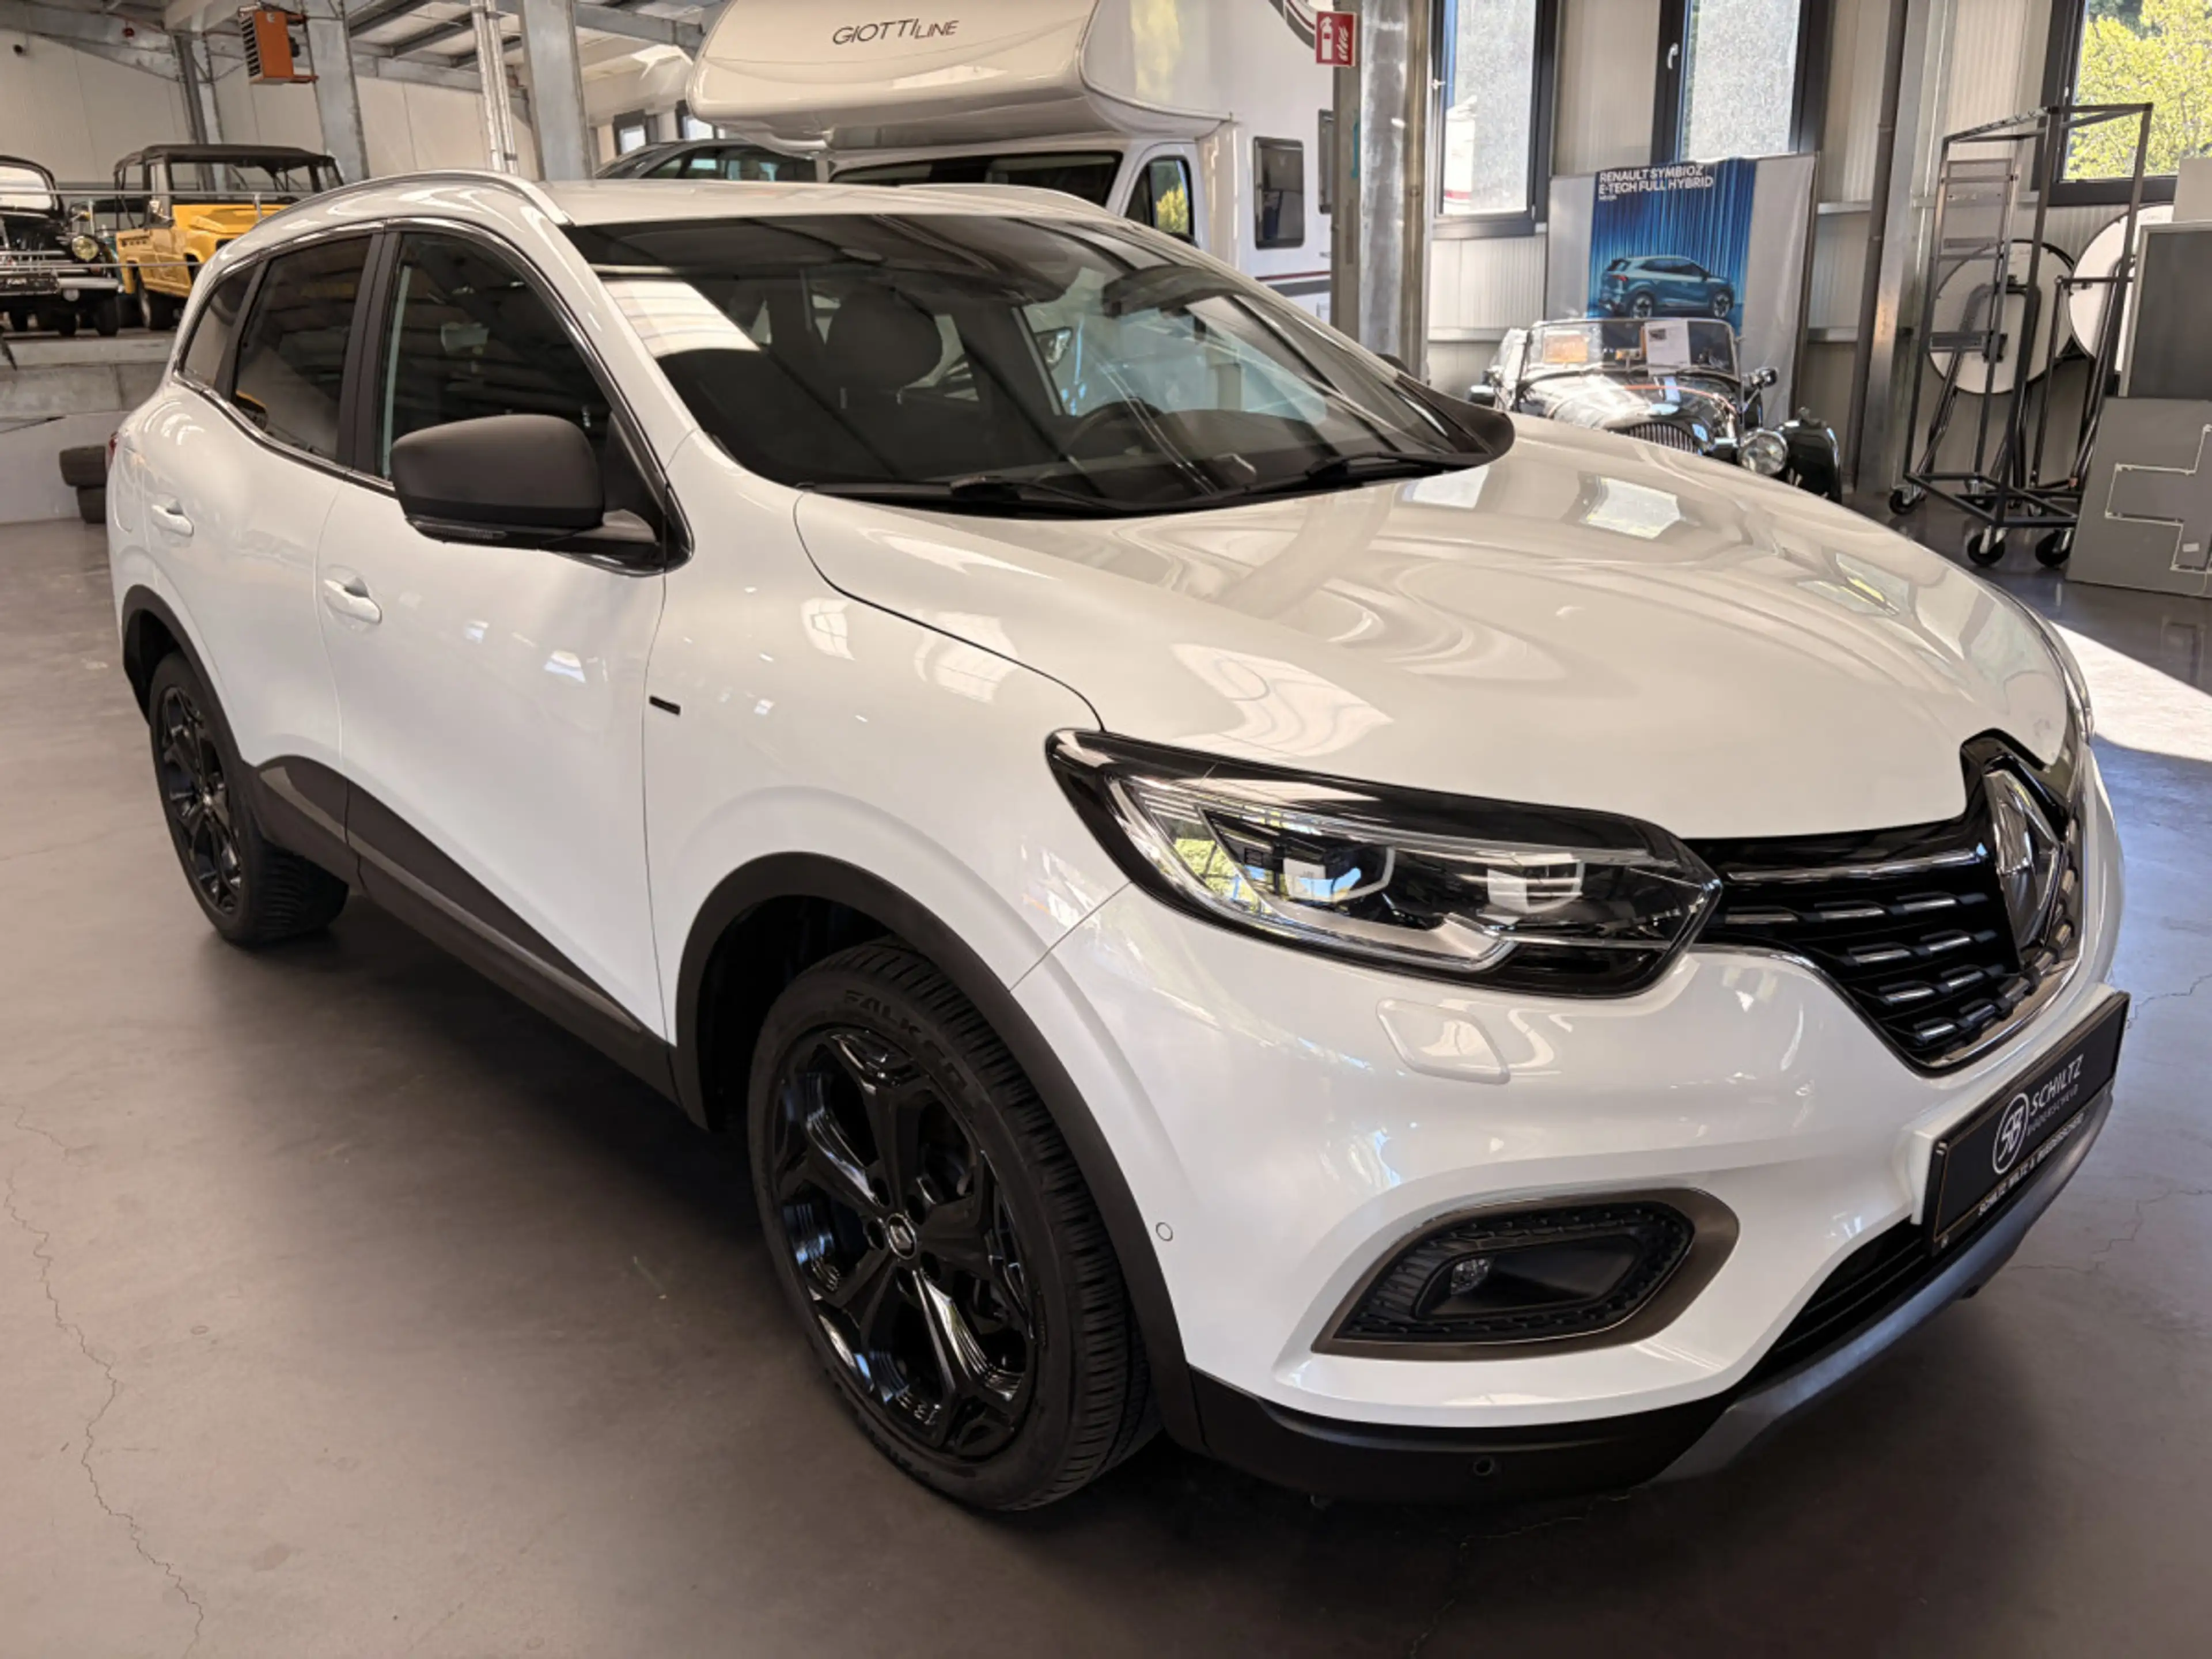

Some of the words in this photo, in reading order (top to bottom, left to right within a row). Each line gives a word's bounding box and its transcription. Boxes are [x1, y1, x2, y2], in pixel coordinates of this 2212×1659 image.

[1599, 168, 1648, 183] RENAULT
[1650, 165, 1704, 179] SYMBIOZ
[1599, 180, 1637, 195] E-TECH
[1639, 180, 1665, 192] FULL
[1668, 176, 1713, 190] HYBRID
[2029, 1054, 2084, 1116] SCHILTZ
